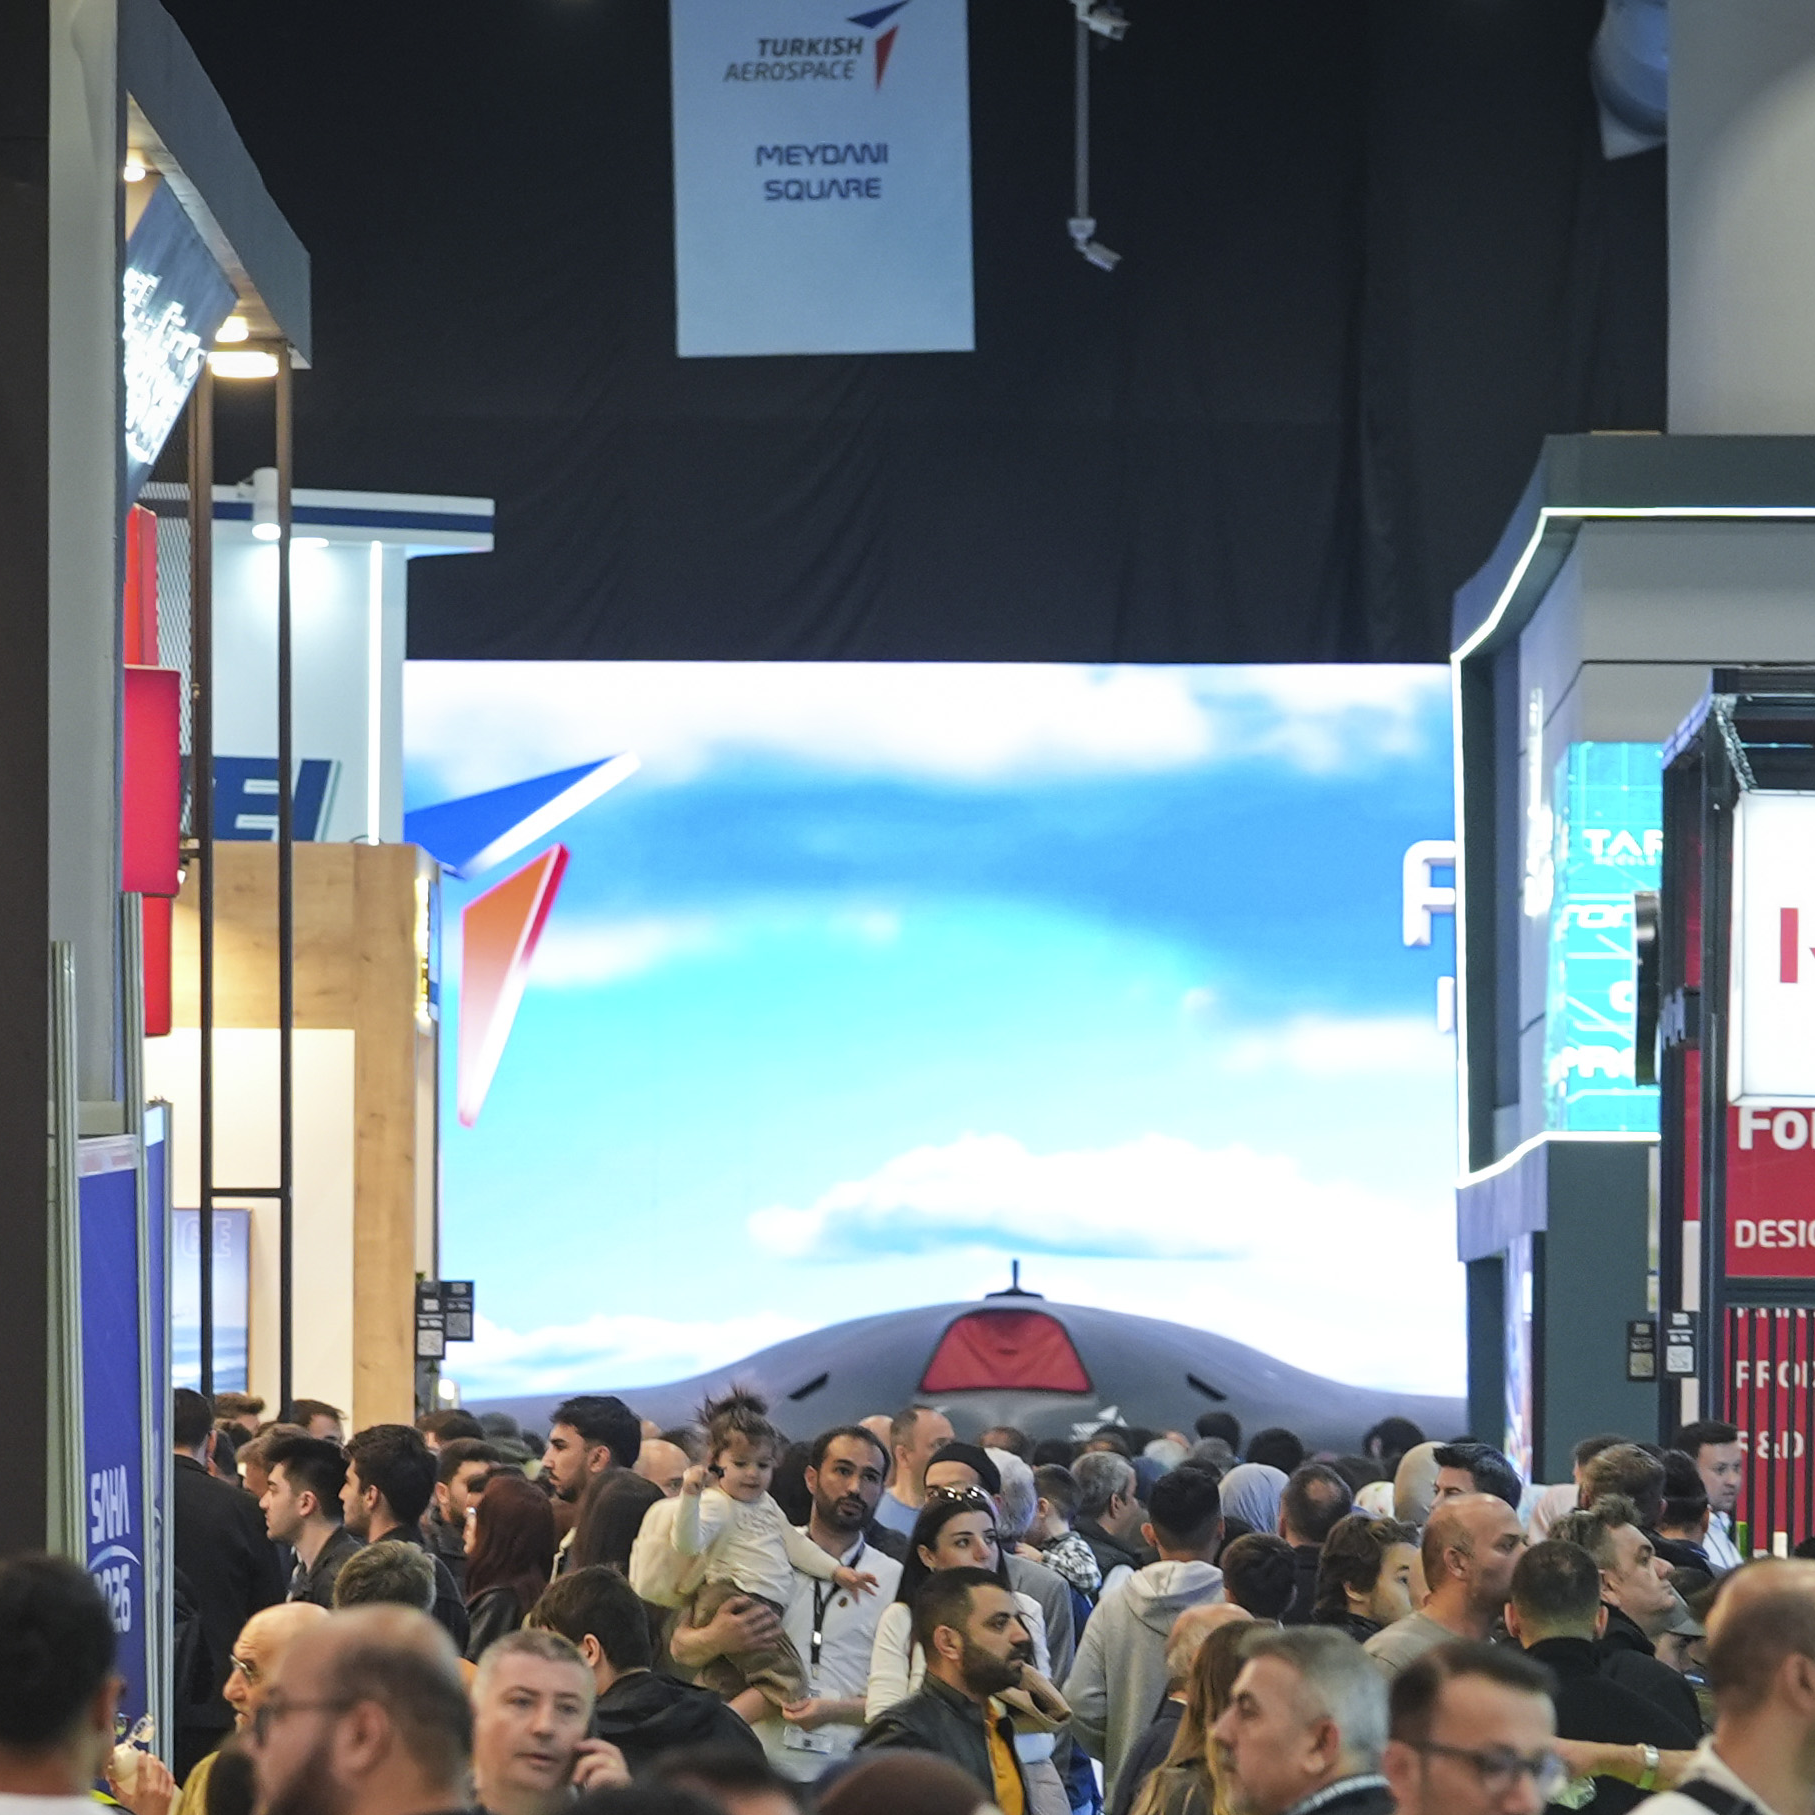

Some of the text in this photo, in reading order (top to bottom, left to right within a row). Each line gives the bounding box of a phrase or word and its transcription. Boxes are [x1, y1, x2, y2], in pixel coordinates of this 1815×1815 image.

[757, 36, 864, 58] TURKISH
[723, 59, 857, 83] AEROSPACE
[755, 142, 889, 168] MEYDANI
[764, 176, 882, 202] SQUARE
[90, 1463, 131, 1545] SAHA
